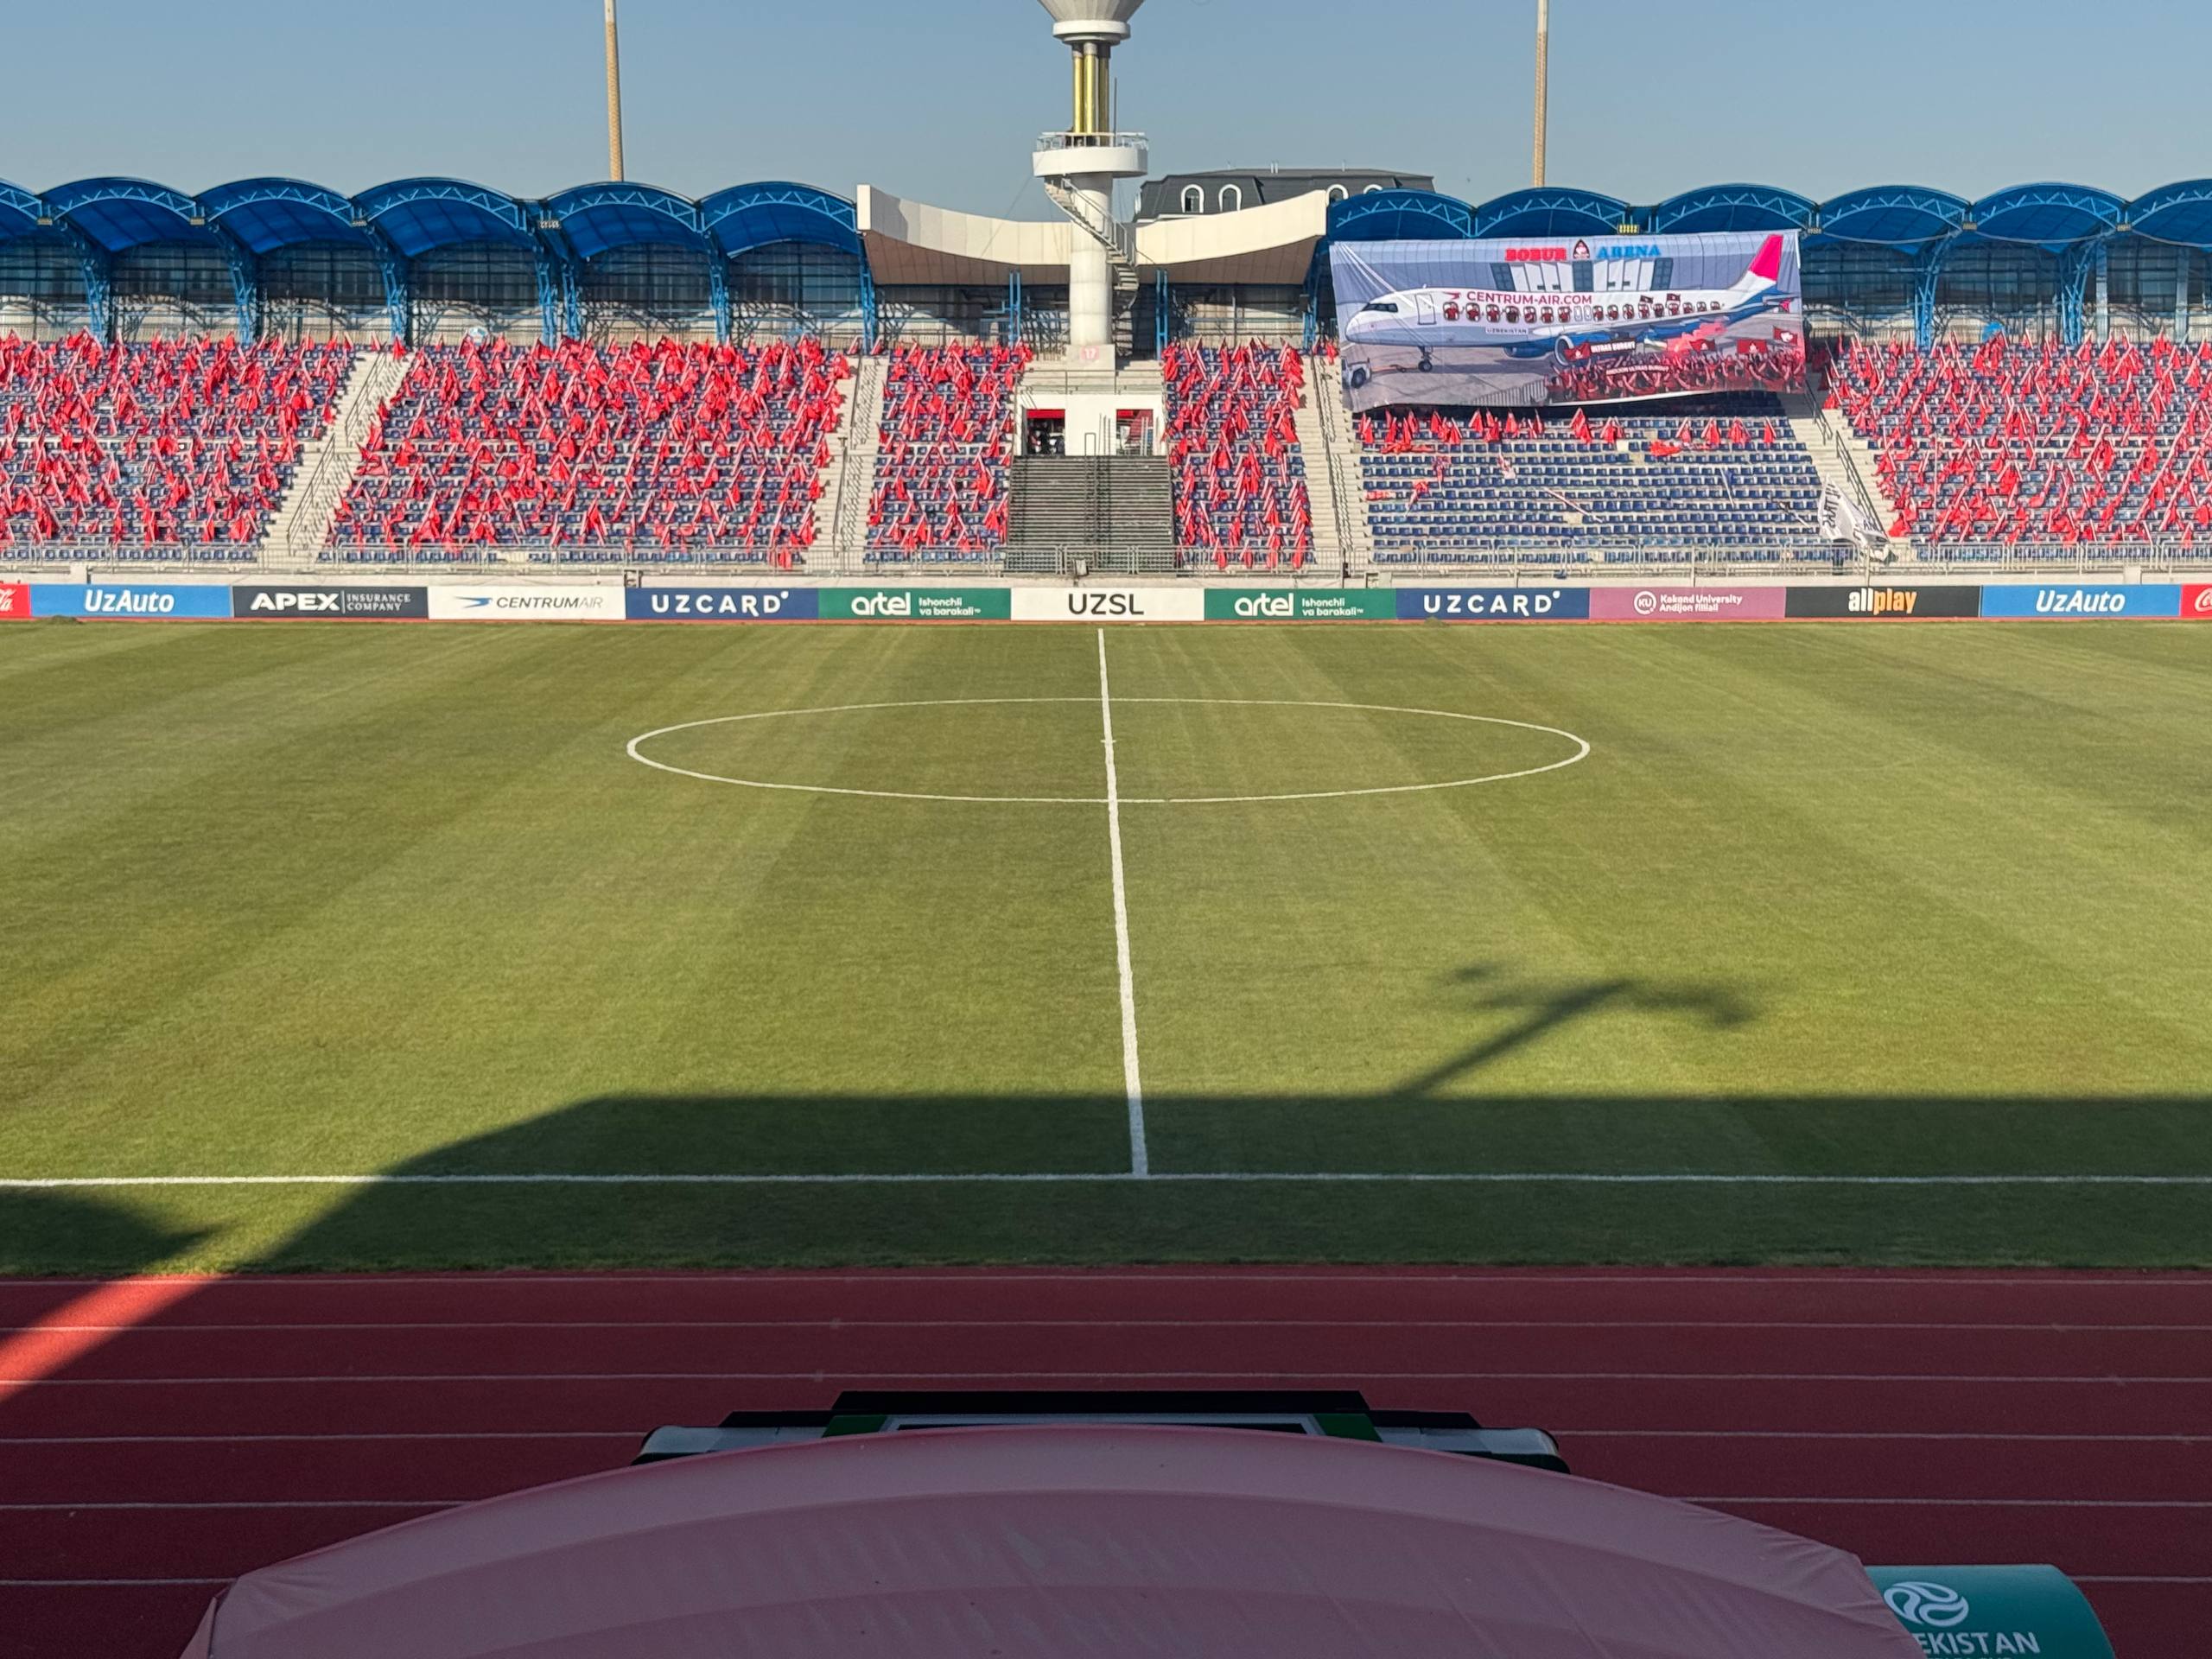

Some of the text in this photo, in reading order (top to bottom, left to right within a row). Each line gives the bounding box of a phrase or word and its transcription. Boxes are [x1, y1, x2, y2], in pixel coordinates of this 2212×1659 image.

[1597, 245, 1661, 258] ARENA
[1467, 291, 1592, 305] CENTRUM-AIR.COM
[85, 589, 175, 613] UzAuto
[251, 593, 340, 611] APEX
[346, 594, 411, 603] INSURANCE
[346, 602, 402, 611] COMPANY
[497, 596, 603, 608] CENTRUMAIR
[652, 594, 782, 616] UZCARD
[851, 592, 912, 615] artel
[918, 597, 963, 607] Ishonchli
[1069, 594, 1144, 614] UZSL
[1234, 593, 1294, 616] artel
[1302, 597, 1345, 607] Ishonchli
[1424, 594, 1553, 616] UZCARD
[1638, 598, 1652, 607] KU
[1660, 594, 1743, 605] Kokand University
[1848, 588, 1917, 615] allplay
[2036, 589, 2126, 613] UzAuto
[1659, 603, 1694, 614] Andijon
[1912, 1631, 2041, 1655] EKISTAN
